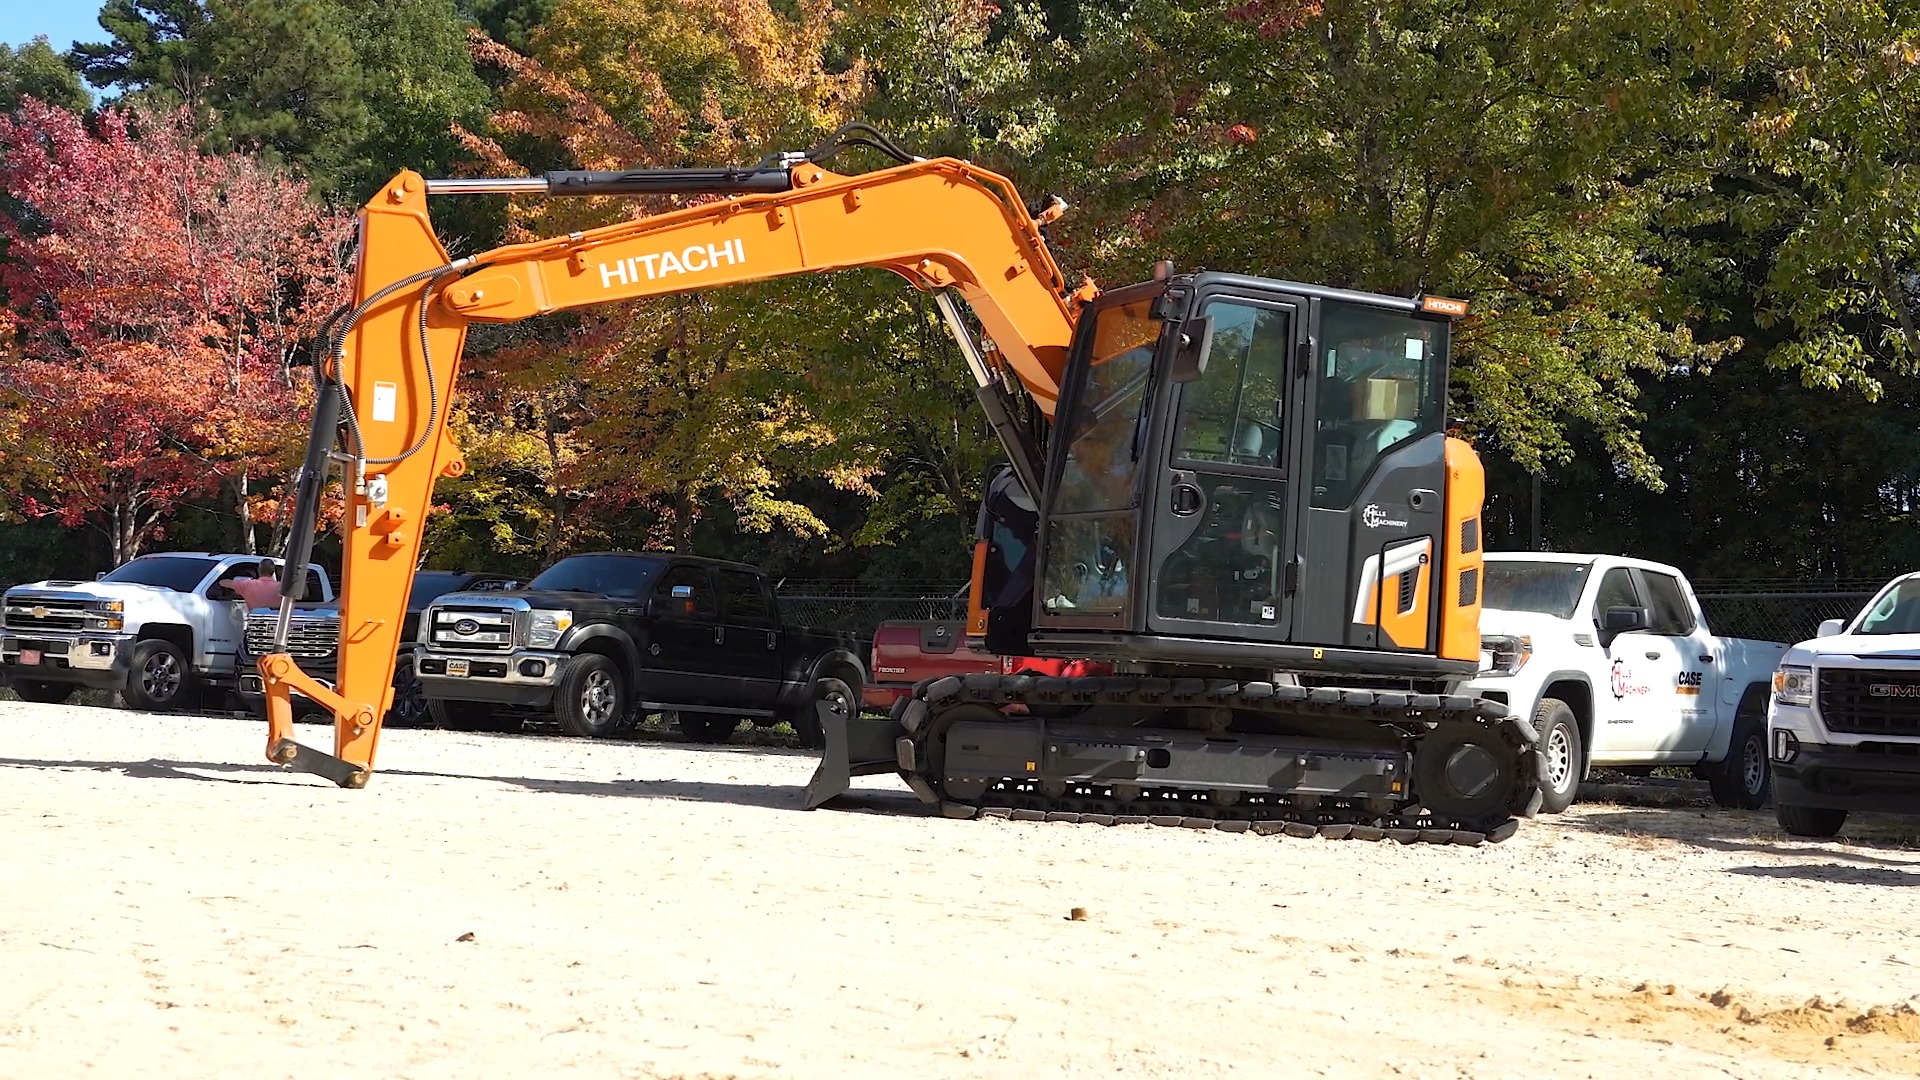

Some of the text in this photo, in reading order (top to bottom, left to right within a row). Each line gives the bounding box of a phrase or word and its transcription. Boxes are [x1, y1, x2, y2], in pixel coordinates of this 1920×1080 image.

[599, 238, 746, 288] HITACHI
[1428, 300, 1462, 311] HITACHI
[1371, 516, 1408, 527] MACHINERY
[449, 662, 467, 670] CASE
[1678, 671, 1703, 686] CASE
[1869, 683, 1920, 698] GM
